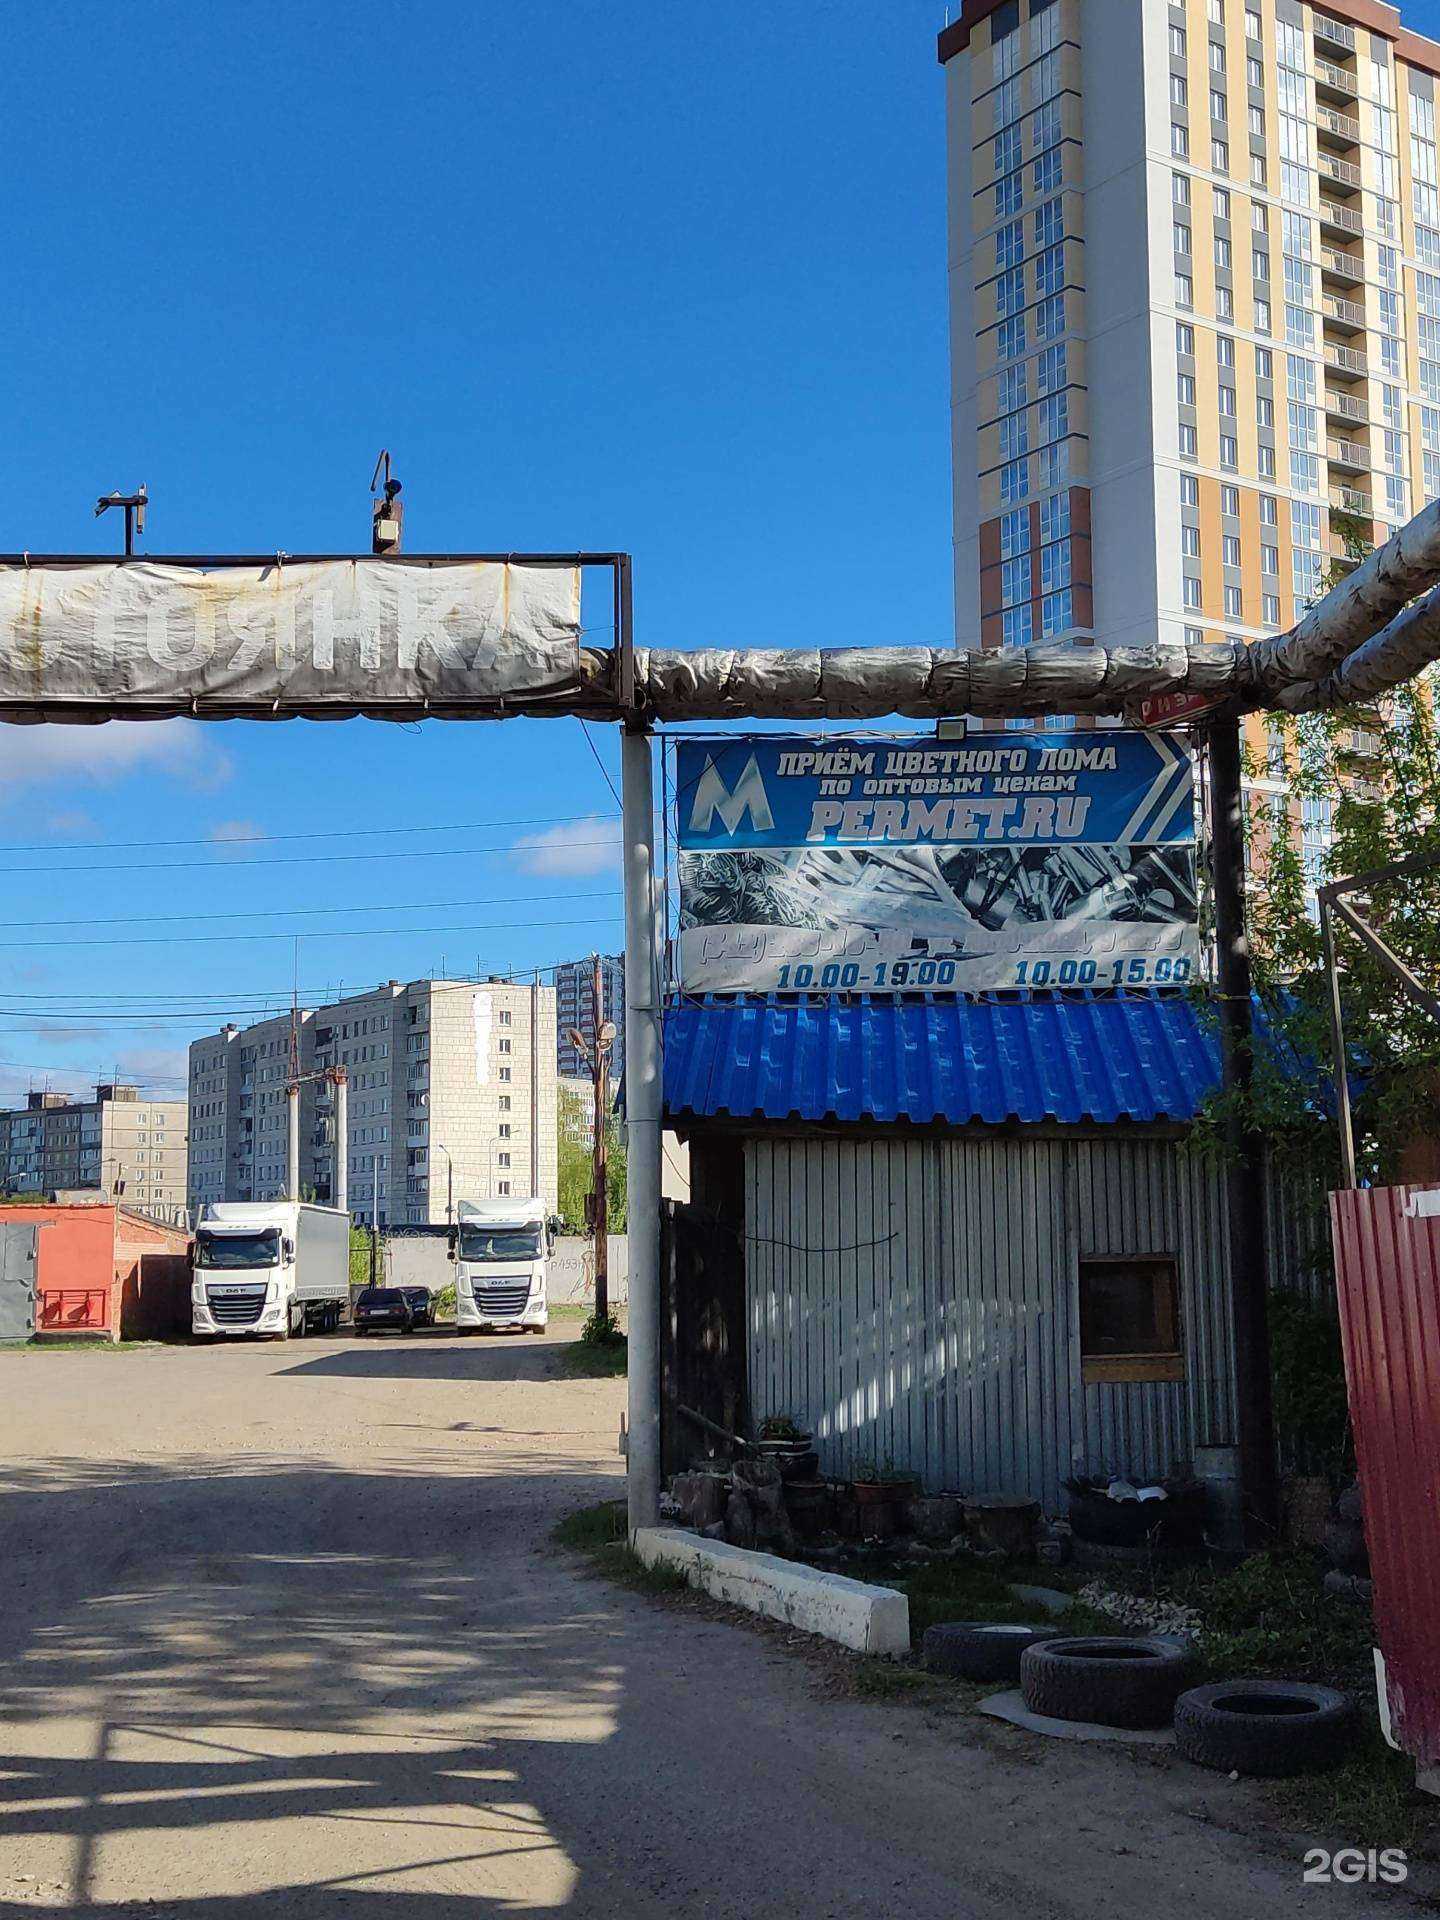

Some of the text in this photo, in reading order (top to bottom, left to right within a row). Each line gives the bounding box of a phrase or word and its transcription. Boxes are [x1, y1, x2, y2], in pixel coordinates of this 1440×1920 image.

[776, 746, 1117, 777] ПРИЁМ ЦВЕТНОГО ЛОМА
[805, 797, 1092, 842] PERMET.RU
[777, 957, 1192, 988] 10.00-19.00 10.00-15.00
